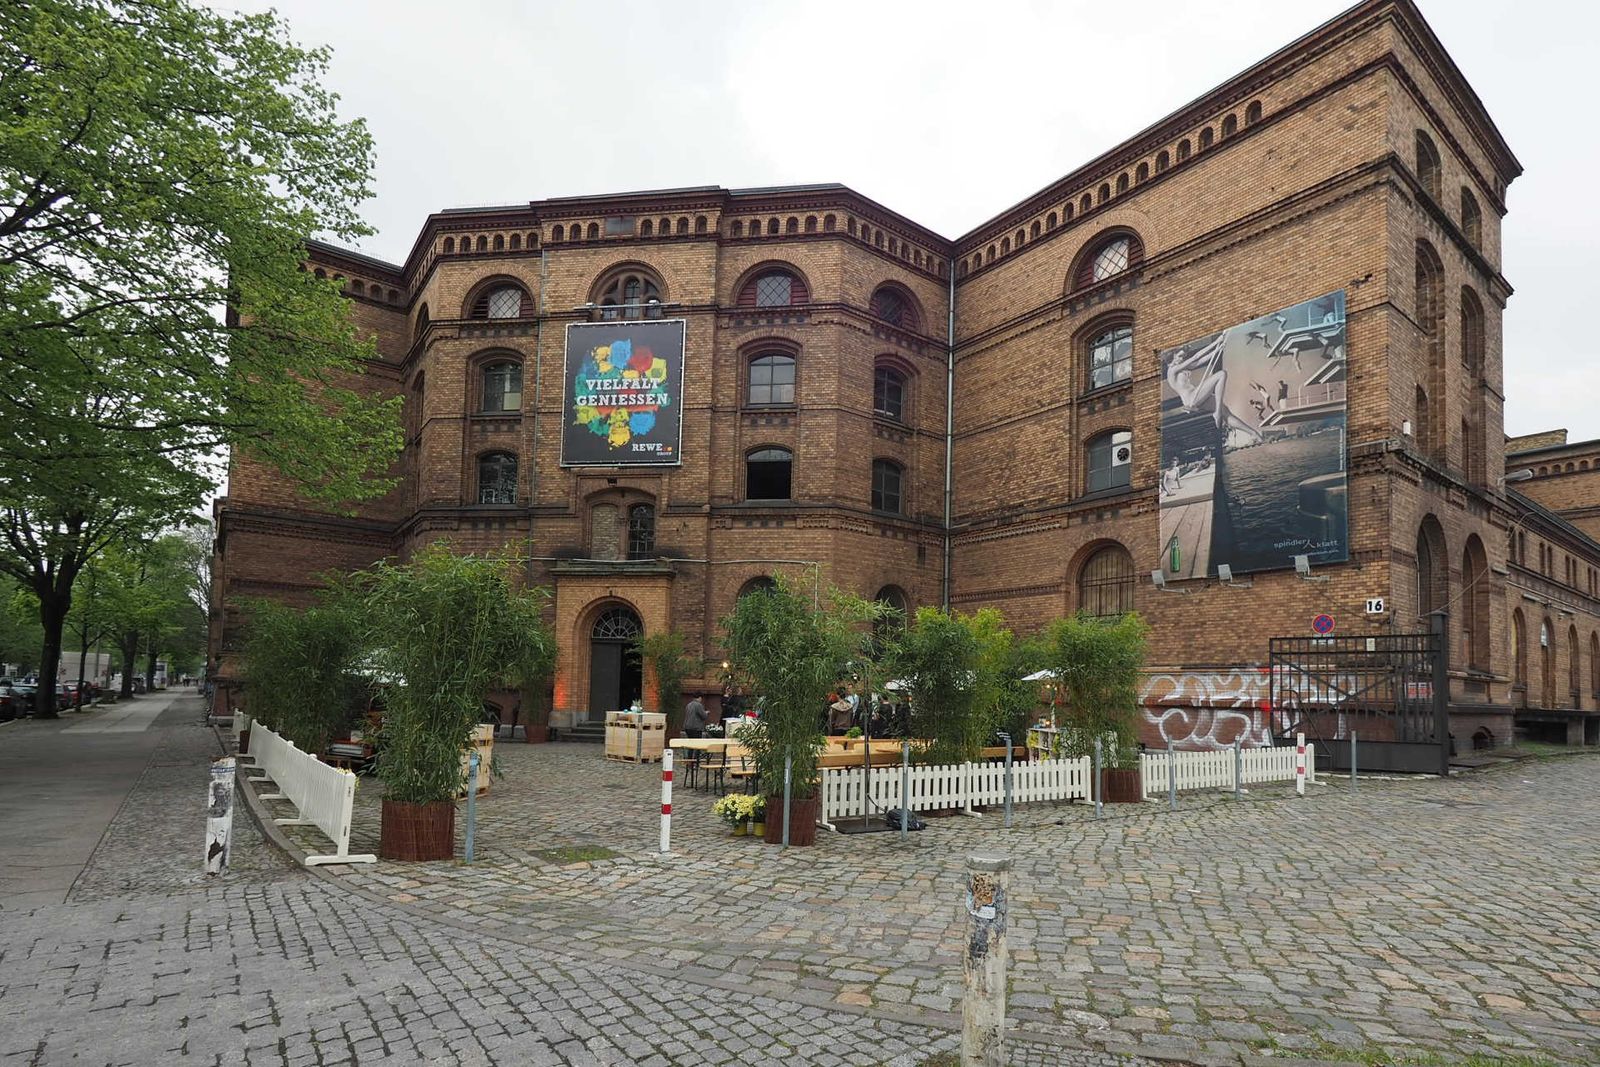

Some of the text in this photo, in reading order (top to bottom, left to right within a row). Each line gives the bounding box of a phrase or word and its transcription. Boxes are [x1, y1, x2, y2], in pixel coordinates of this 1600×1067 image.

[586, 378, 659, 390] VIELFALT
[576, 393, 668, 406] GENIESSEN
[632, 443, 663, 452] REWE
[1367, 601, 1382, 612] 16
